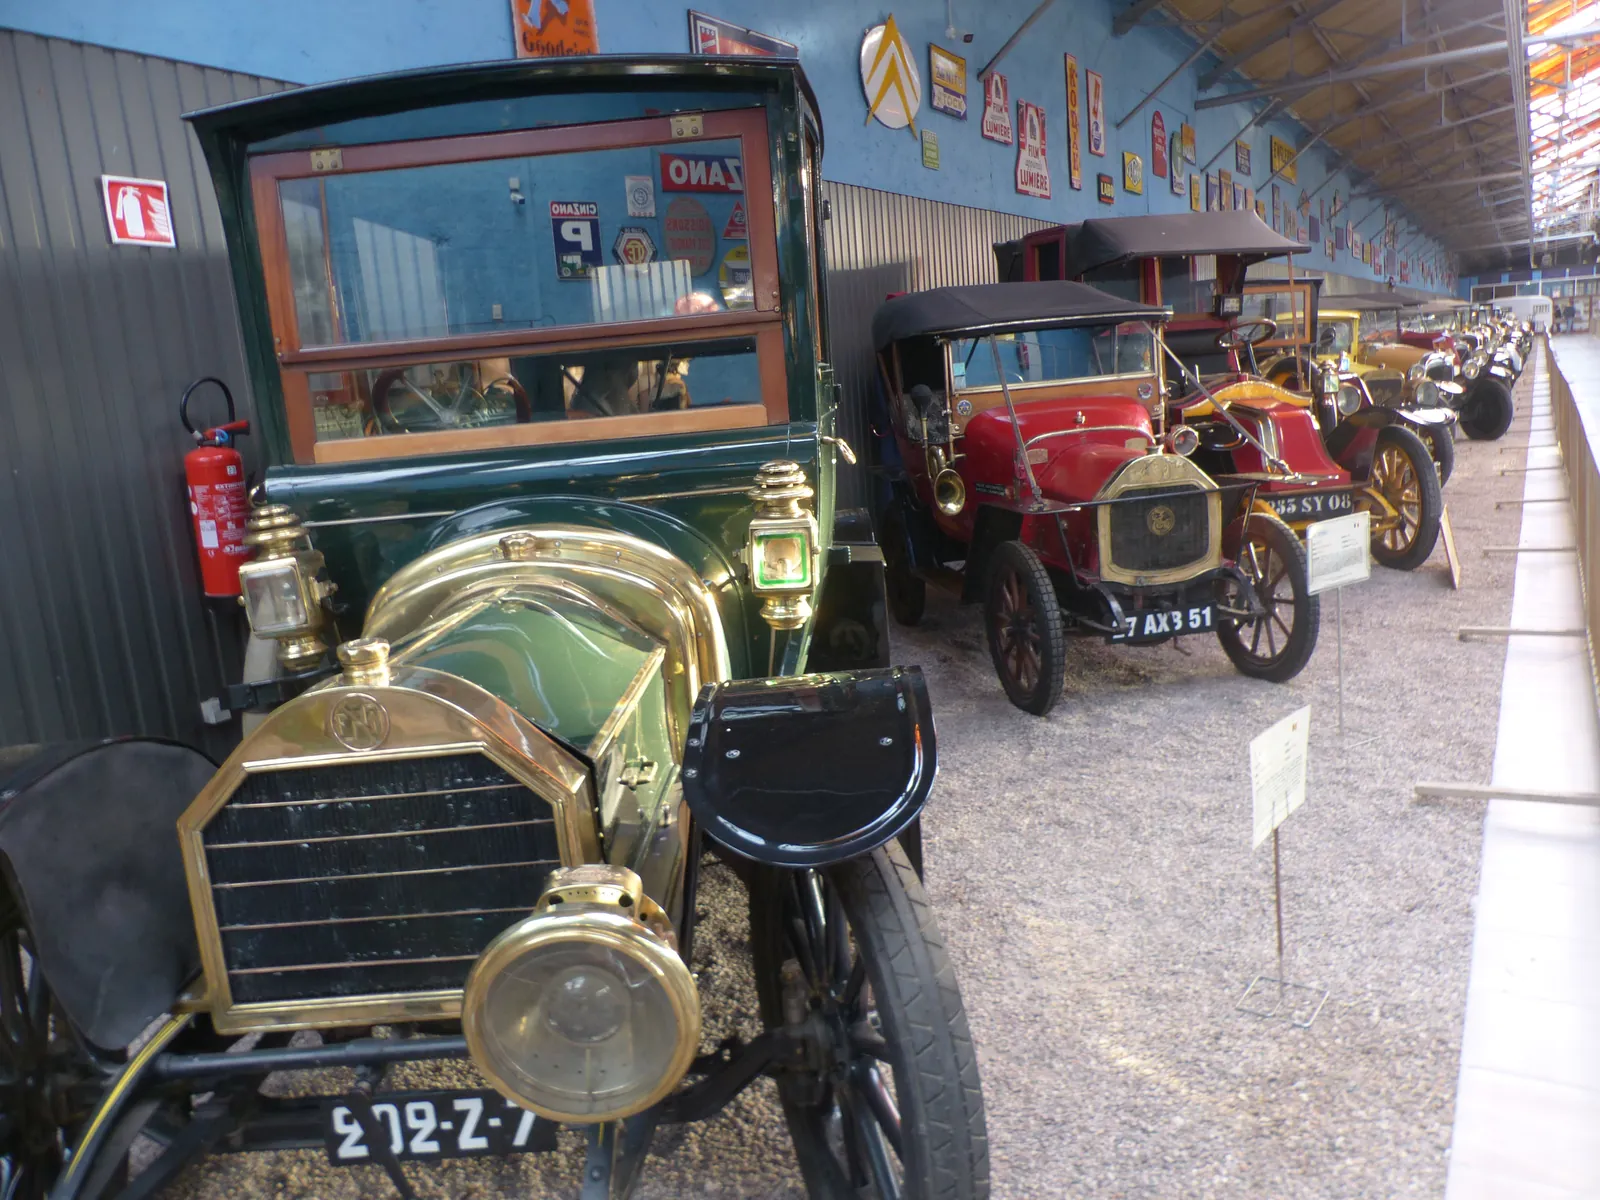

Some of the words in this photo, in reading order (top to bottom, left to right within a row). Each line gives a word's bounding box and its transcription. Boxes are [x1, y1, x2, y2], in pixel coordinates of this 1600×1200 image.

[1028, 144, 1040, 160] FILM
[1301, 496, 1324, 513] SY
[1328, 493, 1351, 511] 08
[1188, 605, 1212, 629] 51
